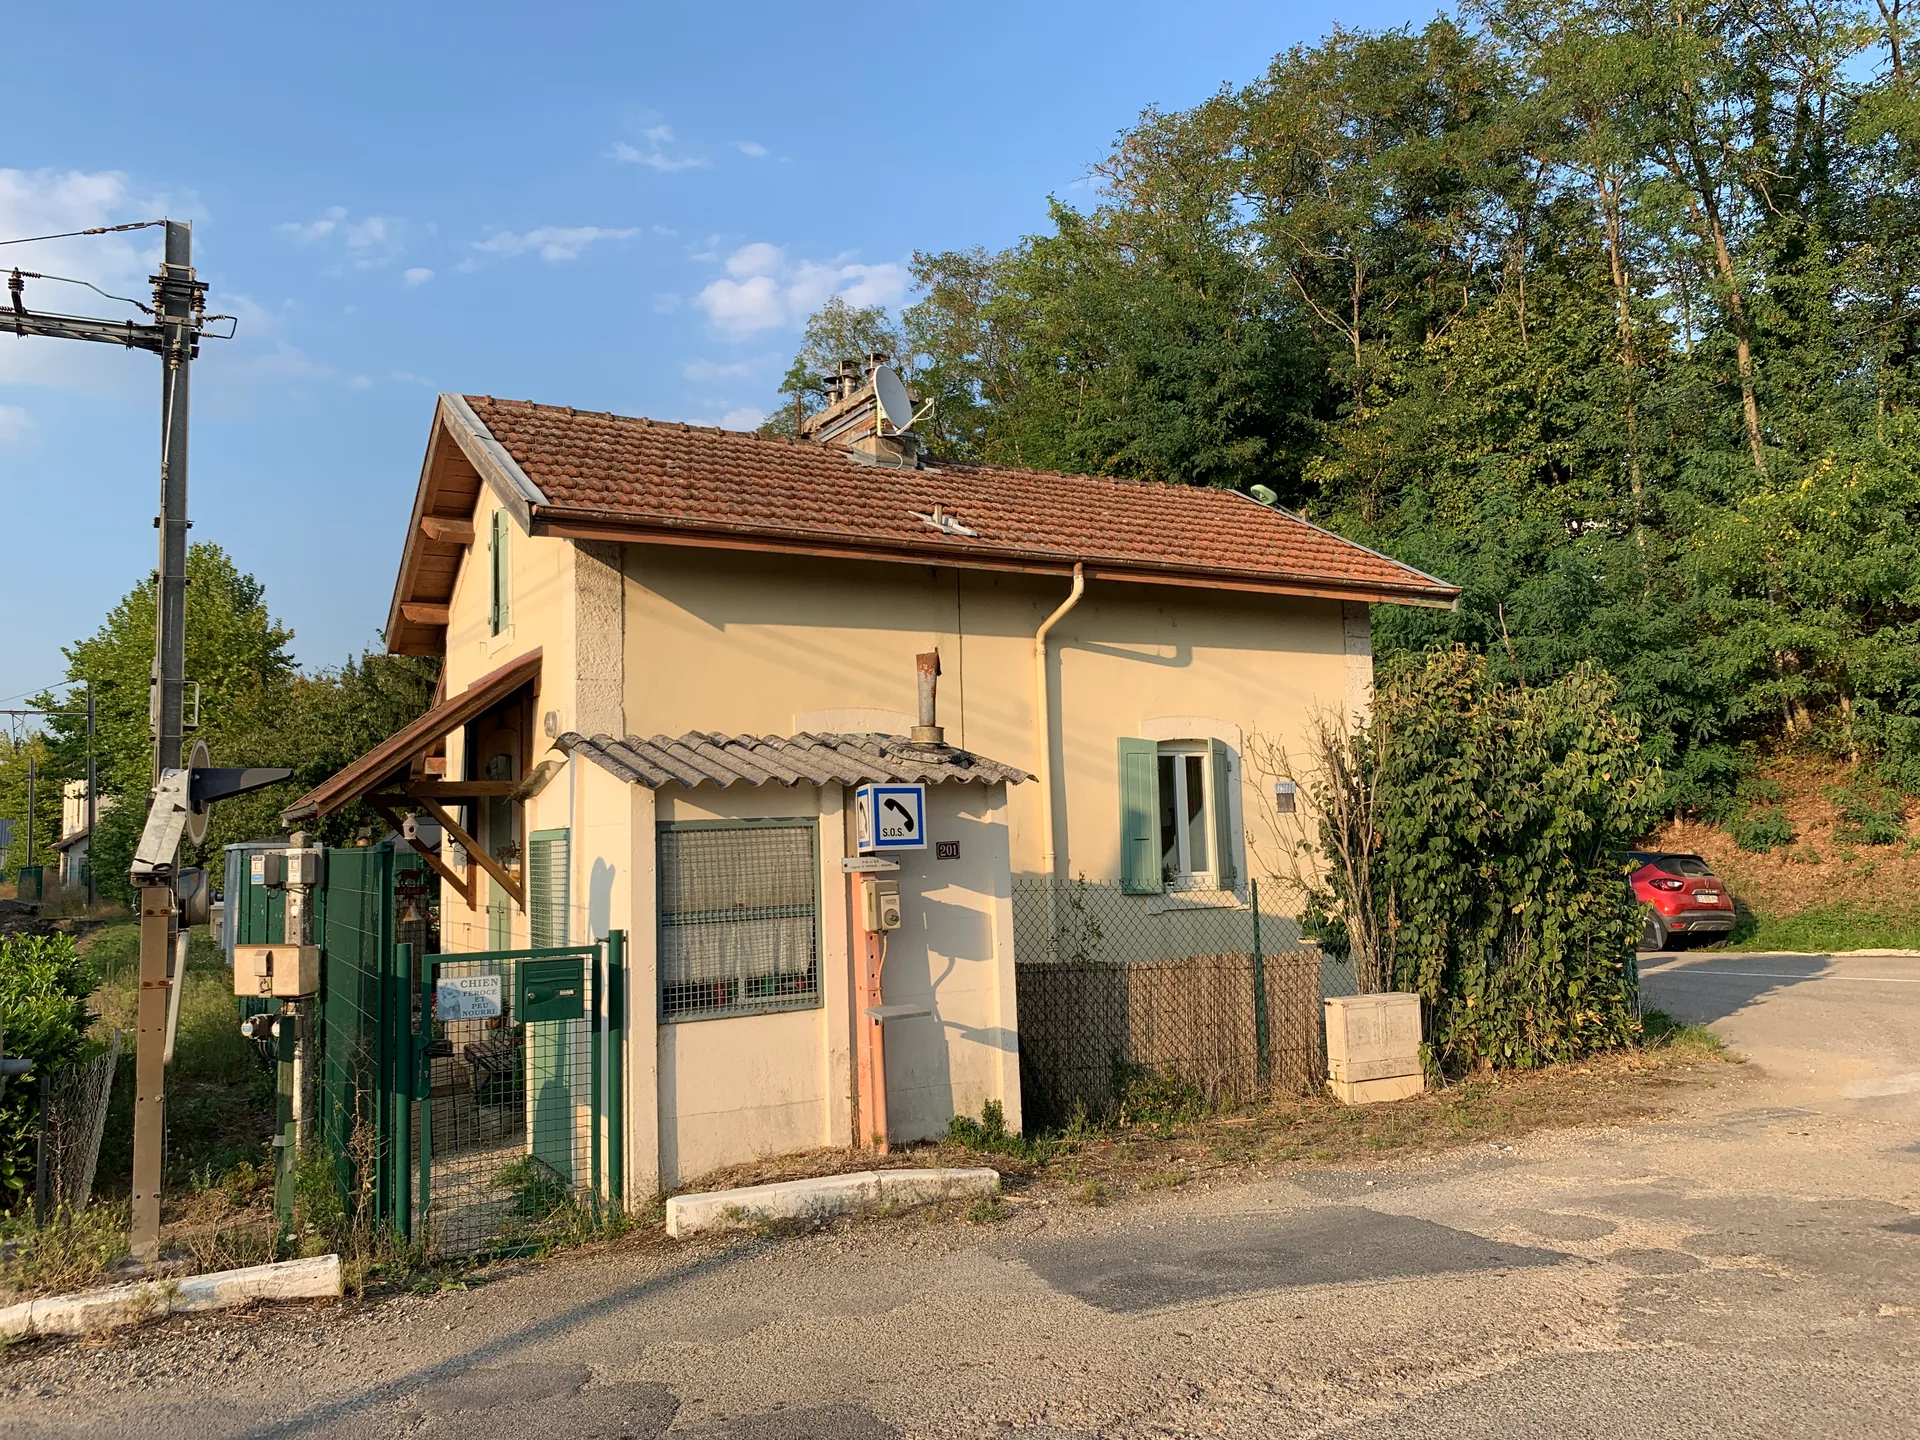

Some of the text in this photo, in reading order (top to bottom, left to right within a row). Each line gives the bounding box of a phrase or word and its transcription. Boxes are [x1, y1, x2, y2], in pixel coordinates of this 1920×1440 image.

[882, 828, 905, 837] S.O.S.
[940, 845, 957, 856] 201
[460, 978, 499, 988] CHIEN
